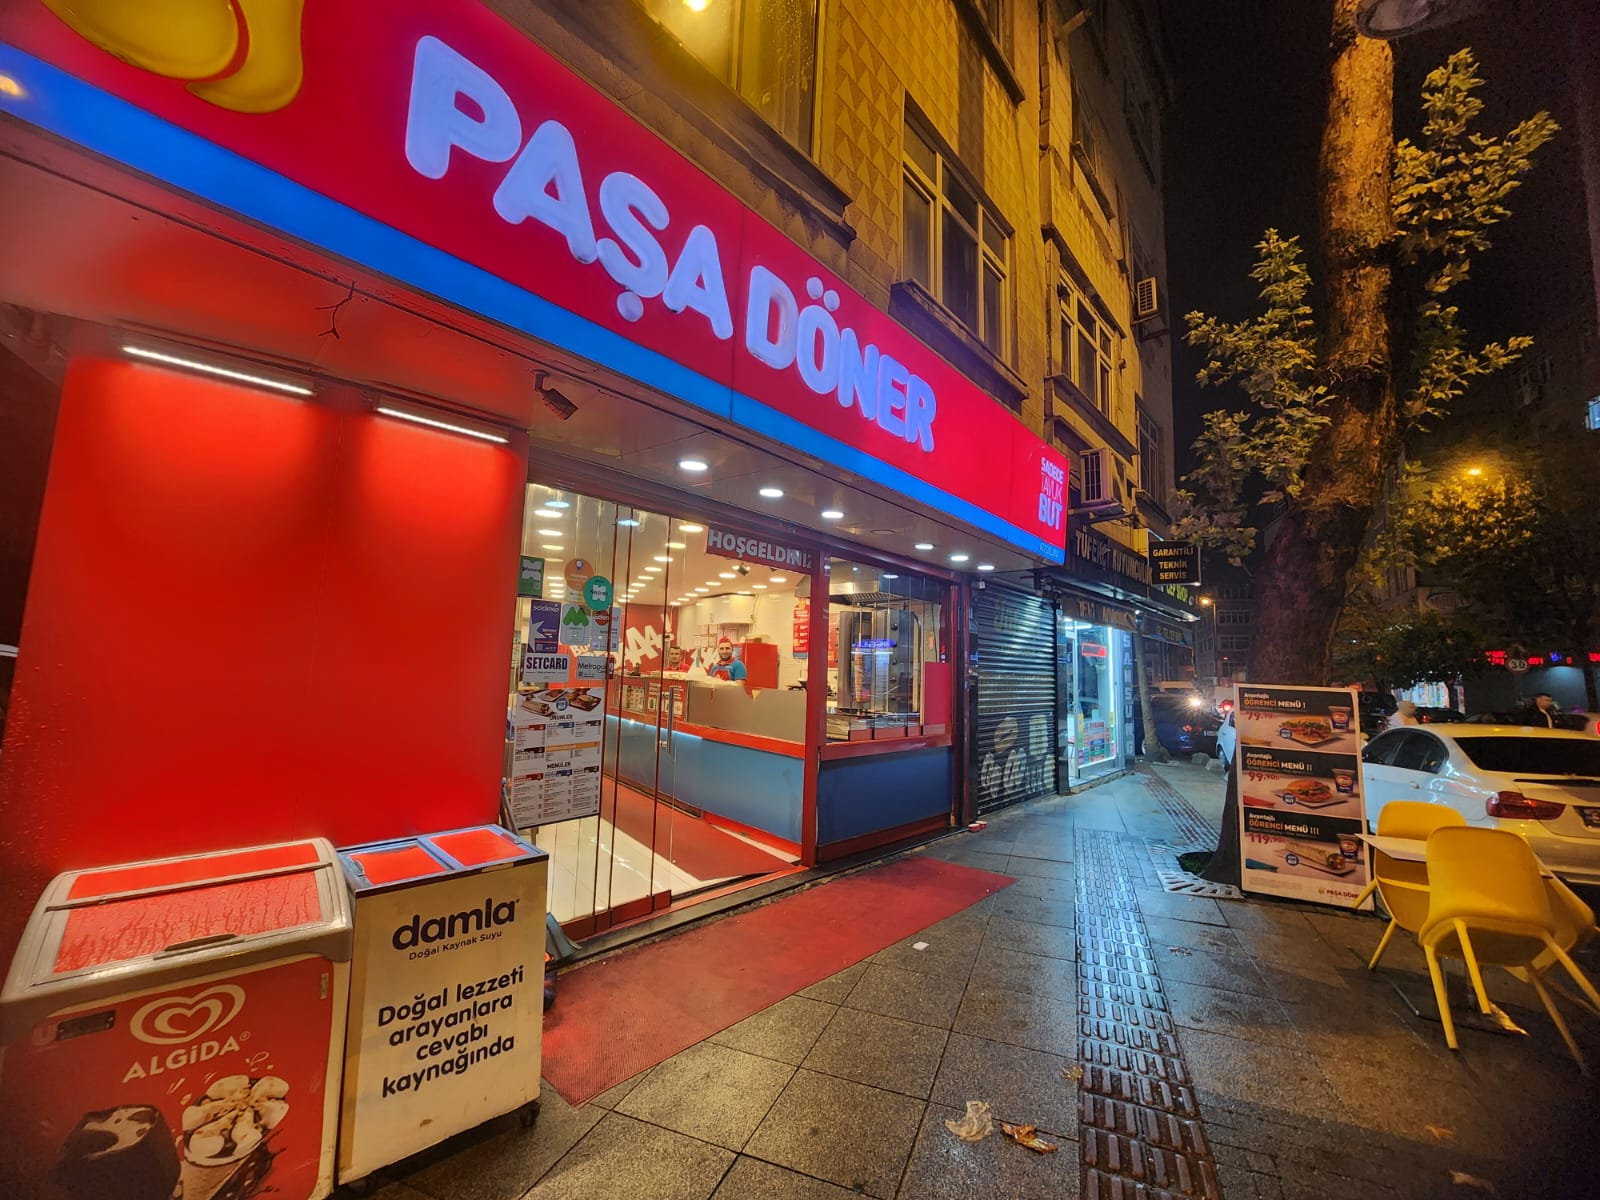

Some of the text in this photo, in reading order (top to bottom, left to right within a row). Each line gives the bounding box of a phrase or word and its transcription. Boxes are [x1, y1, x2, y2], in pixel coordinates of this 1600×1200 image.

[405, 35, 936, 452] PAŞA DÖNER
[1039, 493, 1063, 531] BUT
[1159, 559, 1187, 569] TEKNİK
[1160, 570, 1187, 580] SERVİS
[526, 656, 568, 670] SETCARD
[1511, 661, 1526, 670] 30
[1123, 633, 1134, 754] SAMSUNG
[1278, 700, 1302, 708] MENÜ
[1247, 758, 1280, 768] ÖĞRENCİ
[1281, 762, 1305, 770] MENÜ
[1249, 819, 1284, 830] ÖĞRENCİ
[1285, 824, 1309, 833] MENÜ
[392, 898, 516, 950] damla
[409, 930, 502, 960] Doğal Kaynak Suyu
[378, 965, 524, 1027] Doğal lezzeti
[389, 994, 513, 1046] arayanlara
[416, 1023, 488, 1060] cevabı
[382, 1036, 515, 1098] kaynağında
